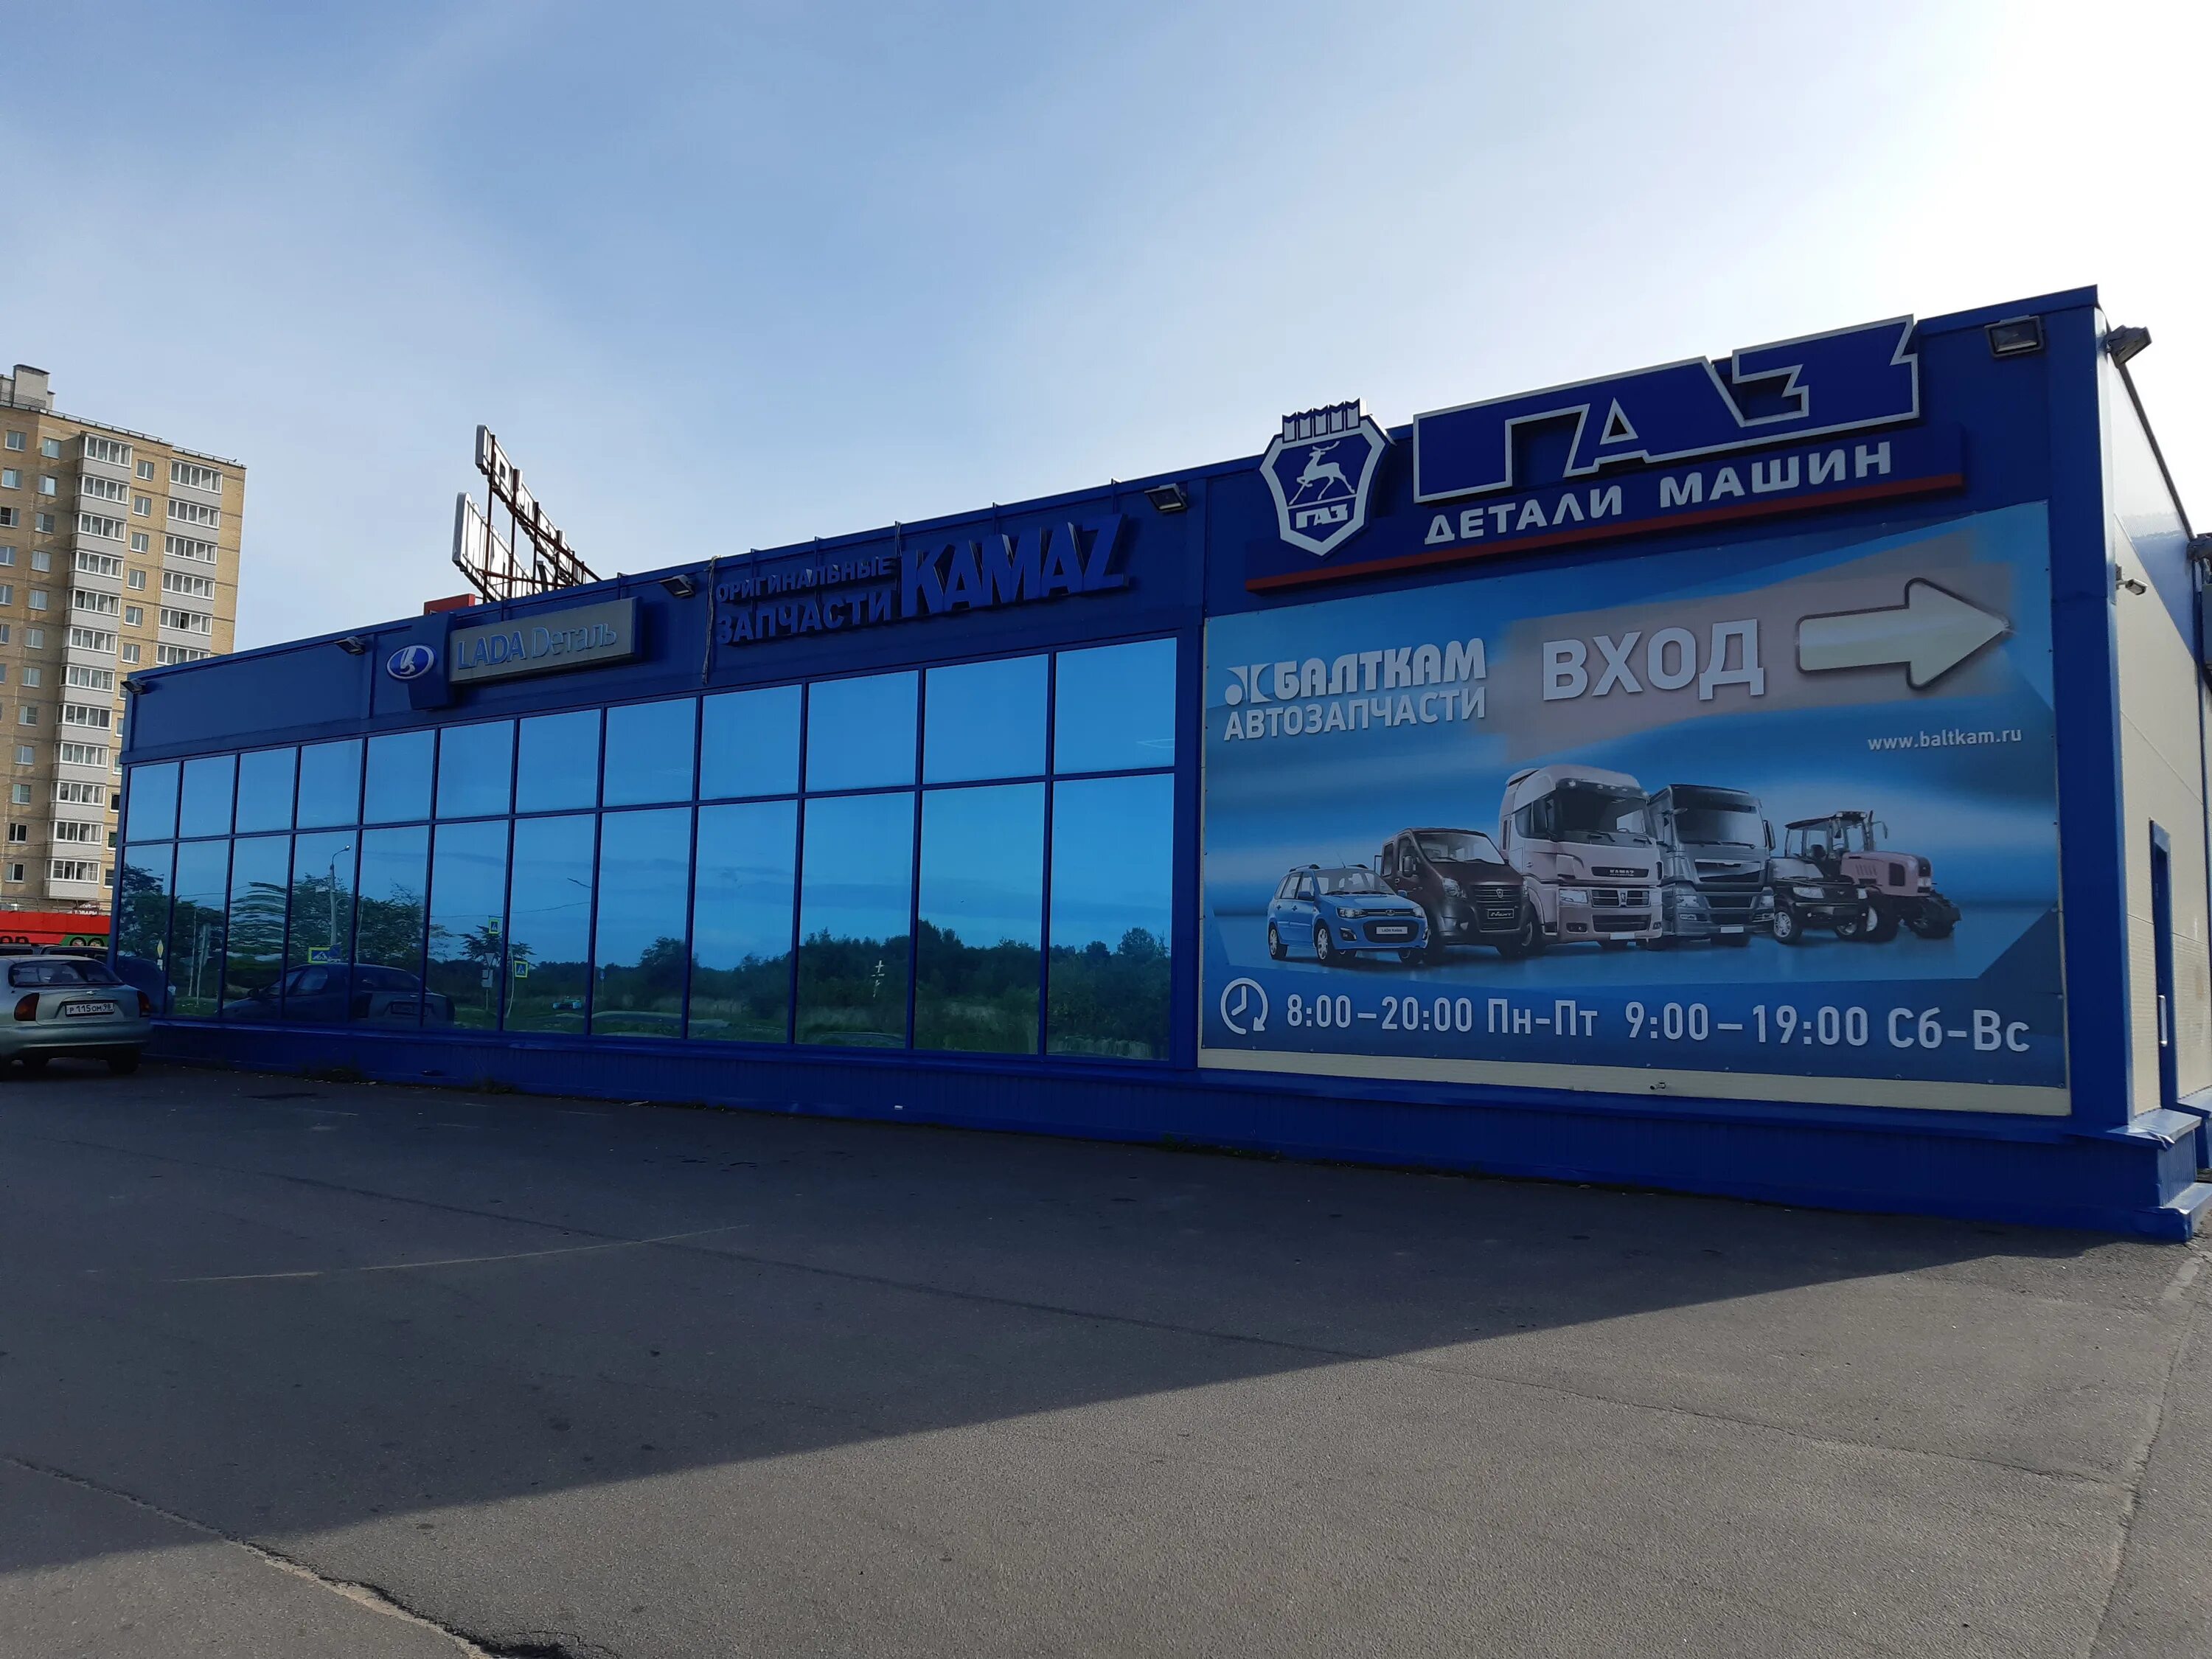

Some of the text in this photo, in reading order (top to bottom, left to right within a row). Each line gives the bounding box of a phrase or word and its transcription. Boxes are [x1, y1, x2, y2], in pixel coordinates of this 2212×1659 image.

[1413, 315, 1919, 502] ГАЗ
[1295, 504, 1349, 529] ГАЗ
[1424, 442, 1892, 546] ДЕТАЛИ МАШИН
[715, 557, 894, 604] ОРИГИНАЛЬНЫЕ
[902, 514, 1129, 618] KAMAZ
[715, 591, 893, 645] ЗАПЧАСТИ
[457, 630, 526, 669] LADA
[1273, 638, 1486, 700] БАЛТКАМ
[1543, 618, 1764, 701] ВХОД
[1224, 686, 1486, 741] АВТОЗАПЧАСТИ
[1868, 728, 2023, 751] www.baltkam.ru
[1488, 998, 1599, 1036] Пн-Пт
[1888, 1007, 2031, 1051] Сб-Вс
